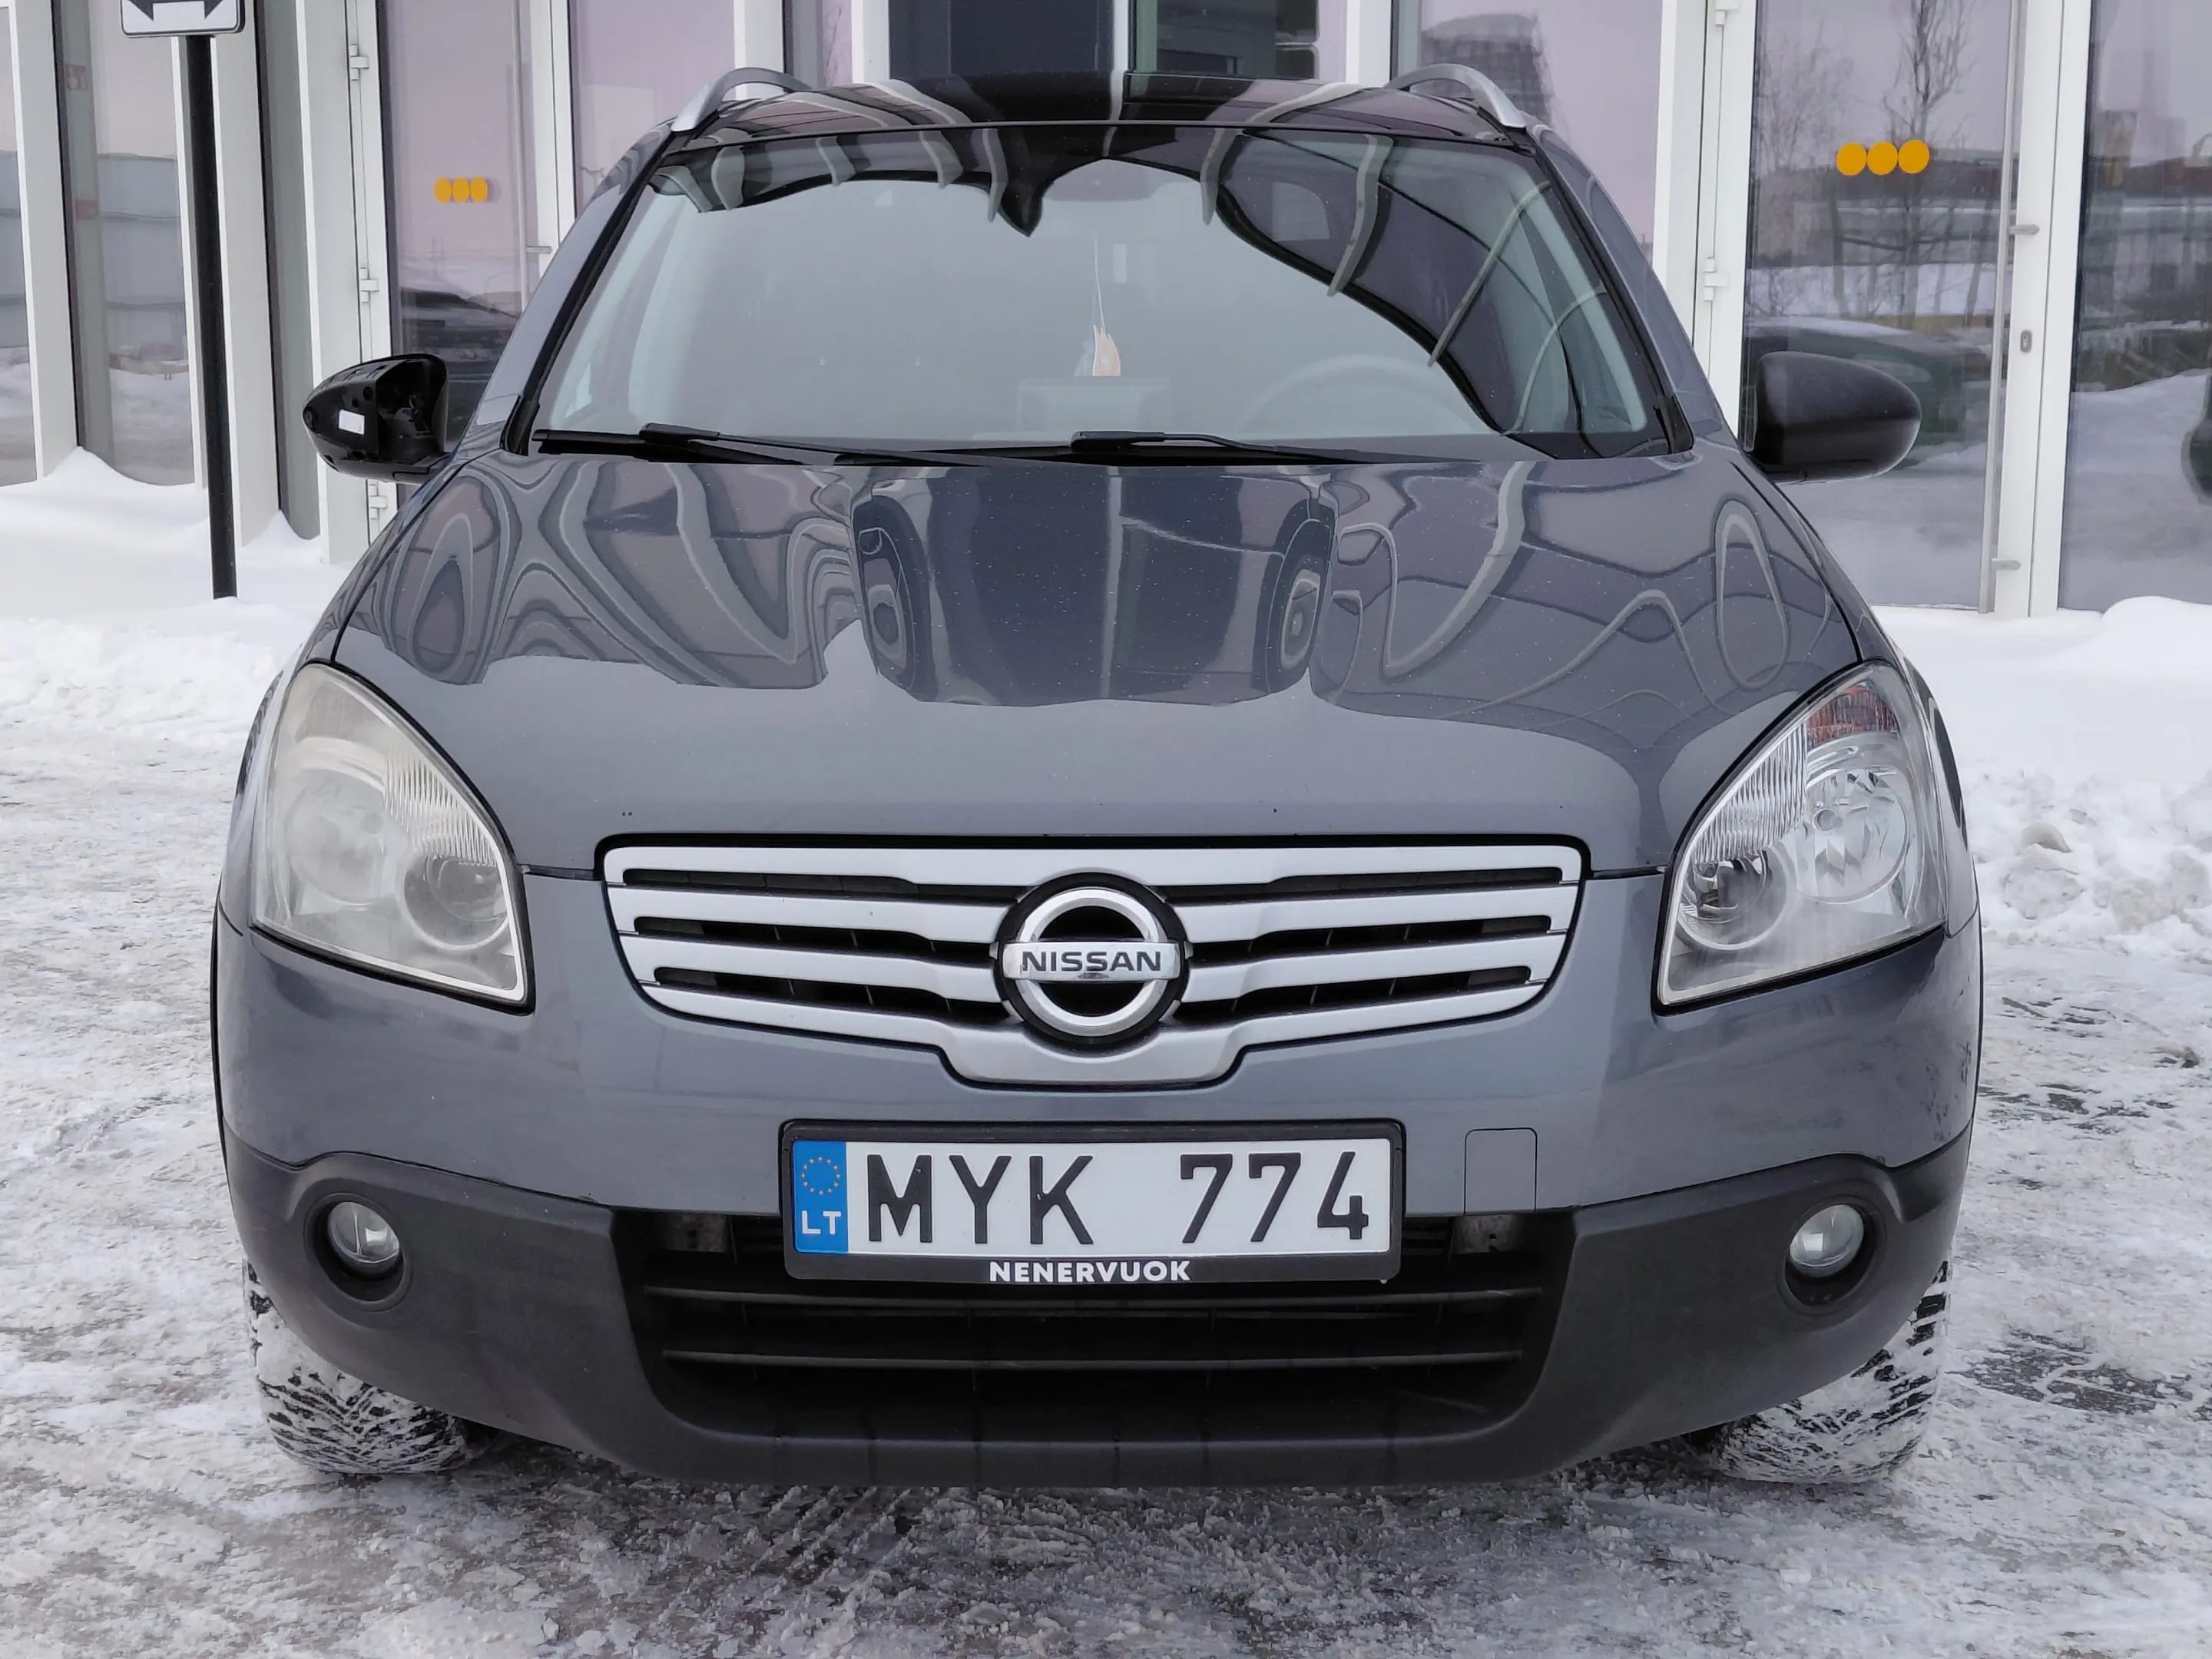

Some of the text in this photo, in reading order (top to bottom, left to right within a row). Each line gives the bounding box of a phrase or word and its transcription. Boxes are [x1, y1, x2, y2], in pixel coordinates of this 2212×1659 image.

[1022, 951, 1161, 972] NISSAN
[867, 1151, 1369, 1244] MYK 774
[802, 1210, 842, 1235] LT
[988, 1260, 1192, 1283] NENERVUOK
